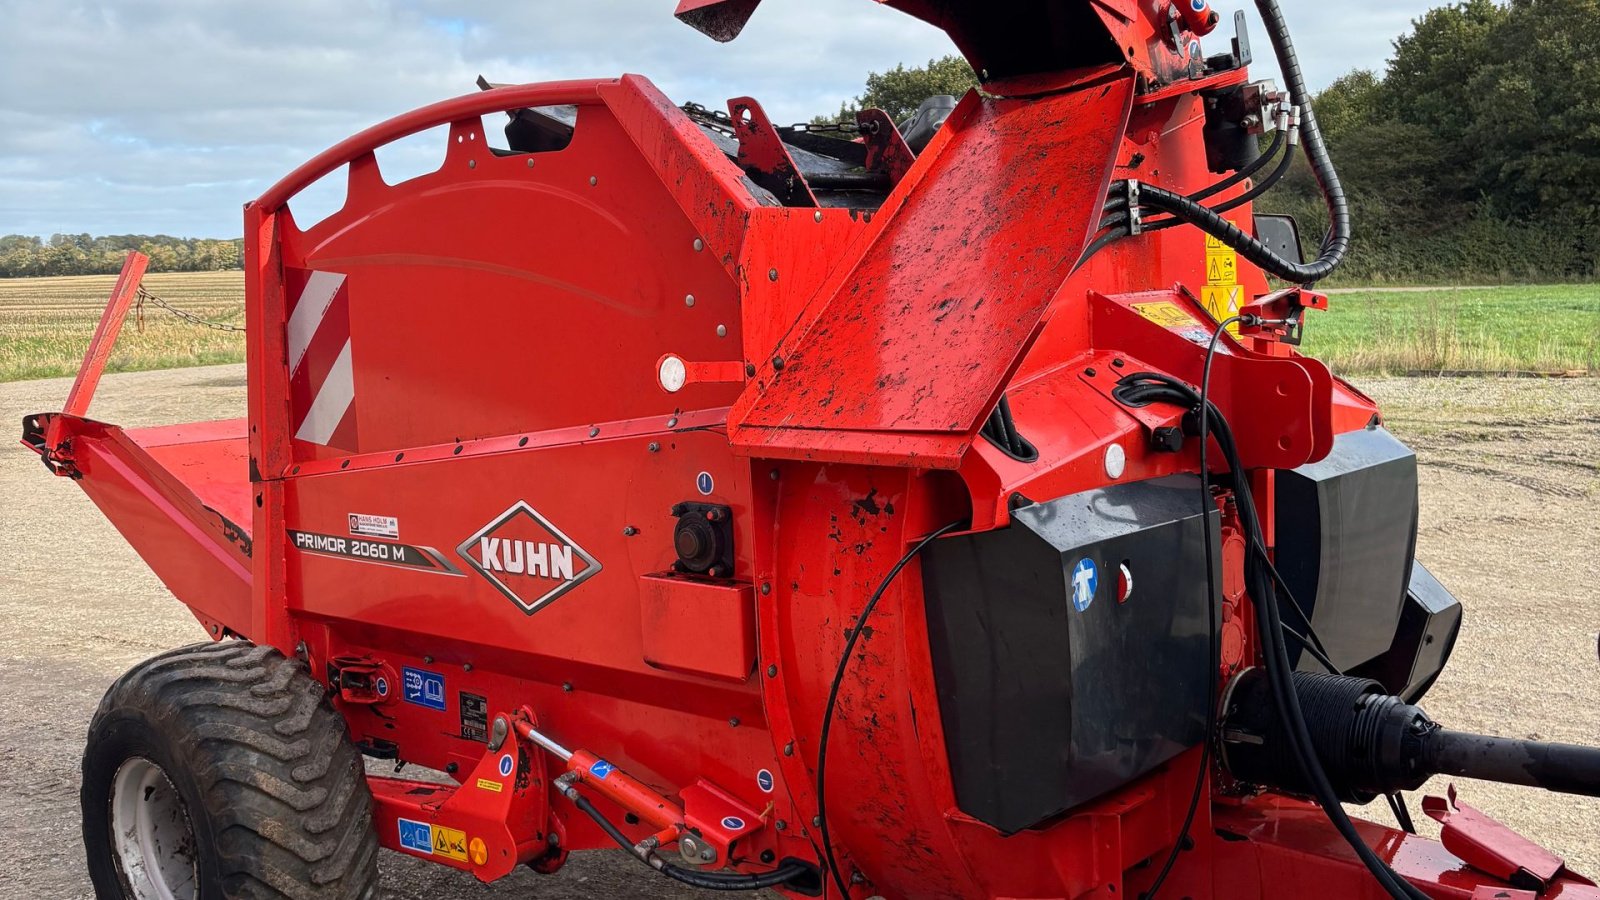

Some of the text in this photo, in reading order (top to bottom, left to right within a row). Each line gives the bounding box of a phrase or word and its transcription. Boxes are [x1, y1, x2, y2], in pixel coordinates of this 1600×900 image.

[296, 533, 405, 561] PRIMOR 2060 M
[481, 536, 574, 581] KUHN
